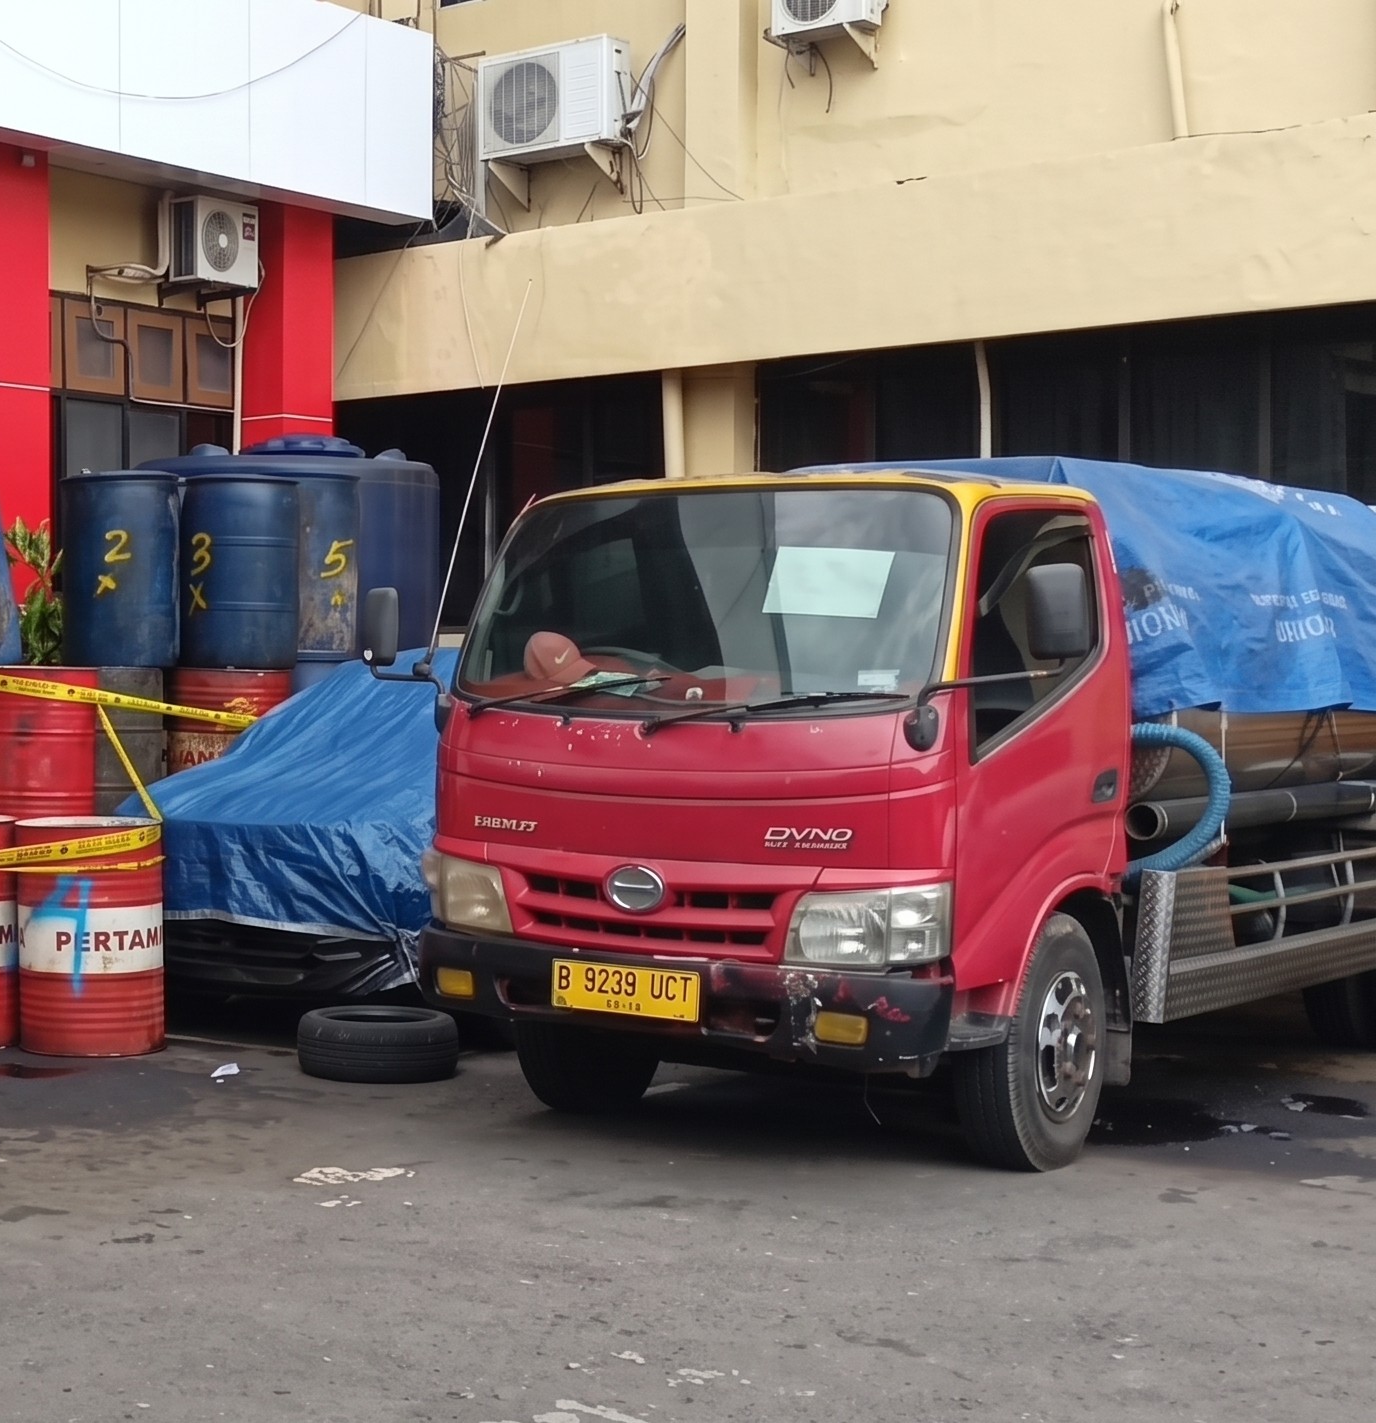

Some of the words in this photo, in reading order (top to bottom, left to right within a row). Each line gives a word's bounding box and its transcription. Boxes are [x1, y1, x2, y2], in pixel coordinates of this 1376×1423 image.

[104, 529, 132, 563] 2
[191, 532, 212, 577] 3
[320, 539, 354, 578] 5
[558, 965, 571, 990] B
[584, 967, 637, 997] 9239
[650, 973, 692, 1003] UCT
